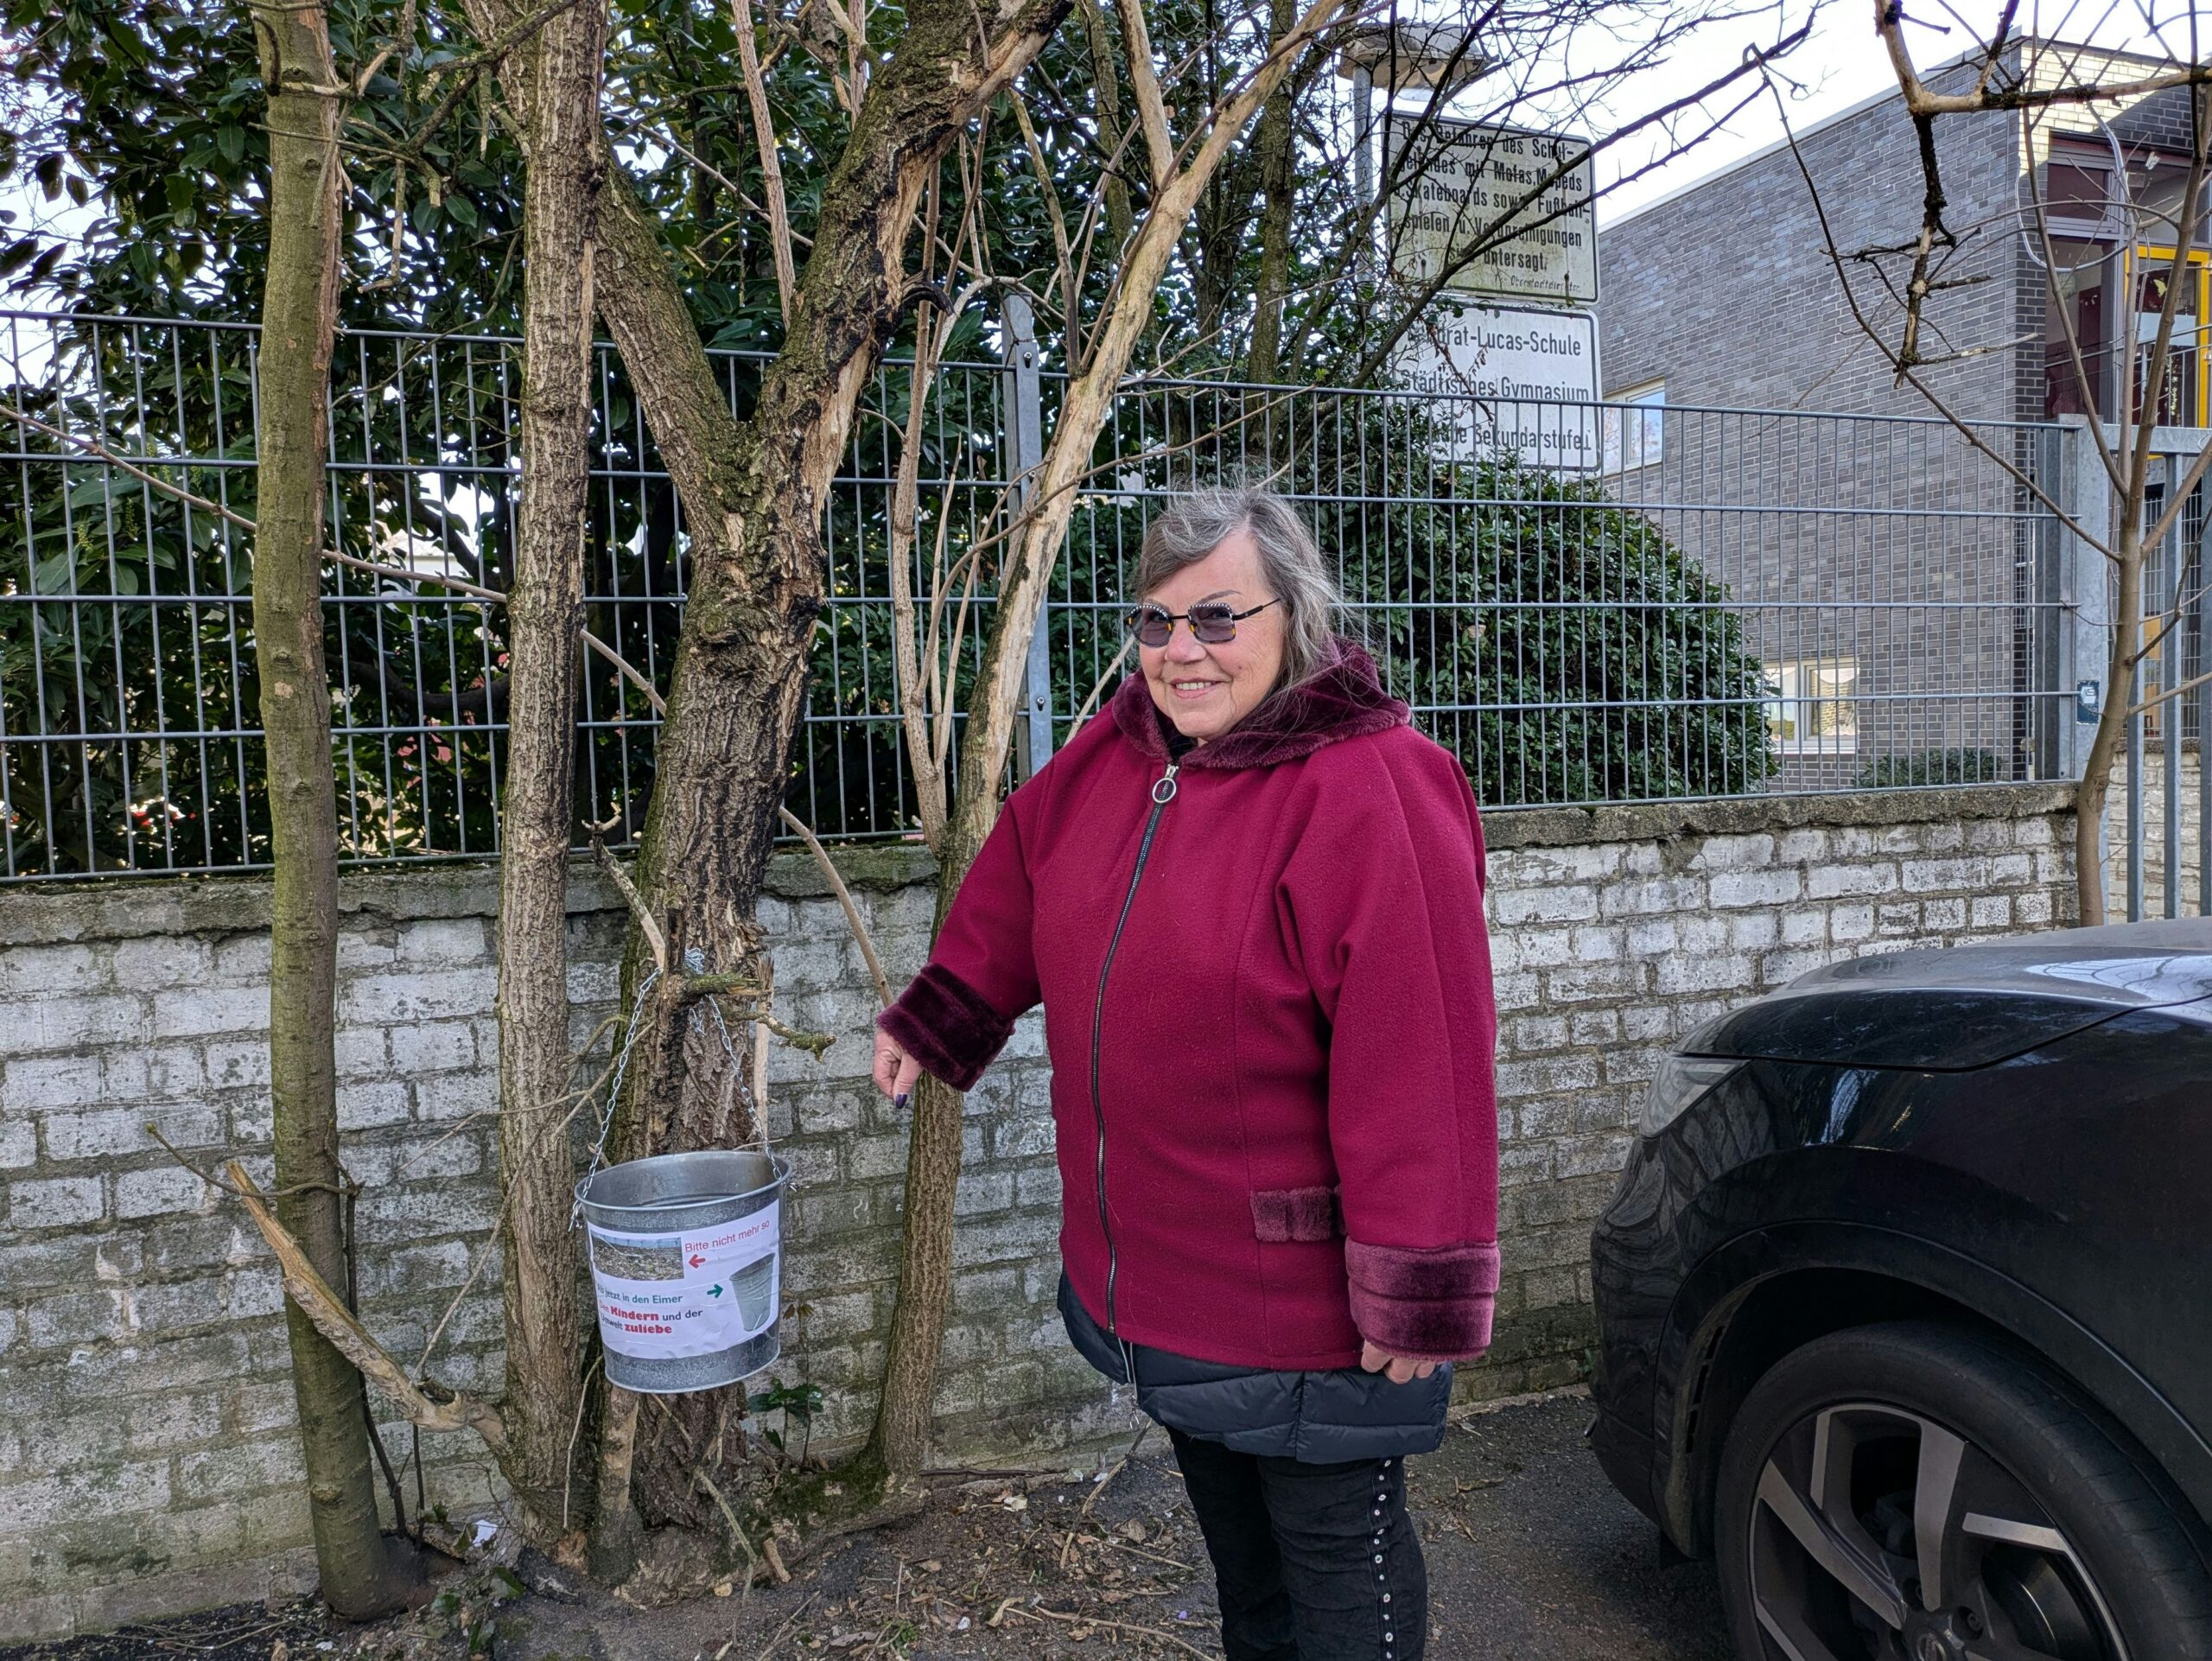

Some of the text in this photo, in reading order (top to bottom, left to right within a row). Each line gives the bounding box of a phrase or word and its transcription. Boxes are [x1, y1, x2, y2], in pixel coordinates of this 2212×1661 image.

[1402, 121, 1427, 143] Ds
[1503, 135, 1523, 155] des
[1398, 150, 1456, 175] elndes
[1465, 159, 1484, 179] mit
[1494, 192, 1529, 212] sow
[1405, 213, 1449, 232] spielen
[1474, 217, 1581, 249] Veunreinigungen
[1408, 323, 1580, 356] drat-Lucas-Schule
[1502, 377, 1589, 402] Gymnasium
[685, 1220, 770, 1252] Bitte nicht mehr so
[605, 1289, 620, 1301] jetzt
[622, 1293, 630, 1301] in
[632, 1295, 649, 1304] den
[652, 1295, 683, 1304] Eimer
[601, 1314, 672, 1333] Umwelt zuliebe
[610, 1306, 659, 1321] Kindern
[662, 1312, 681, 1321] und
[684, 1309, 703, 1319] der
